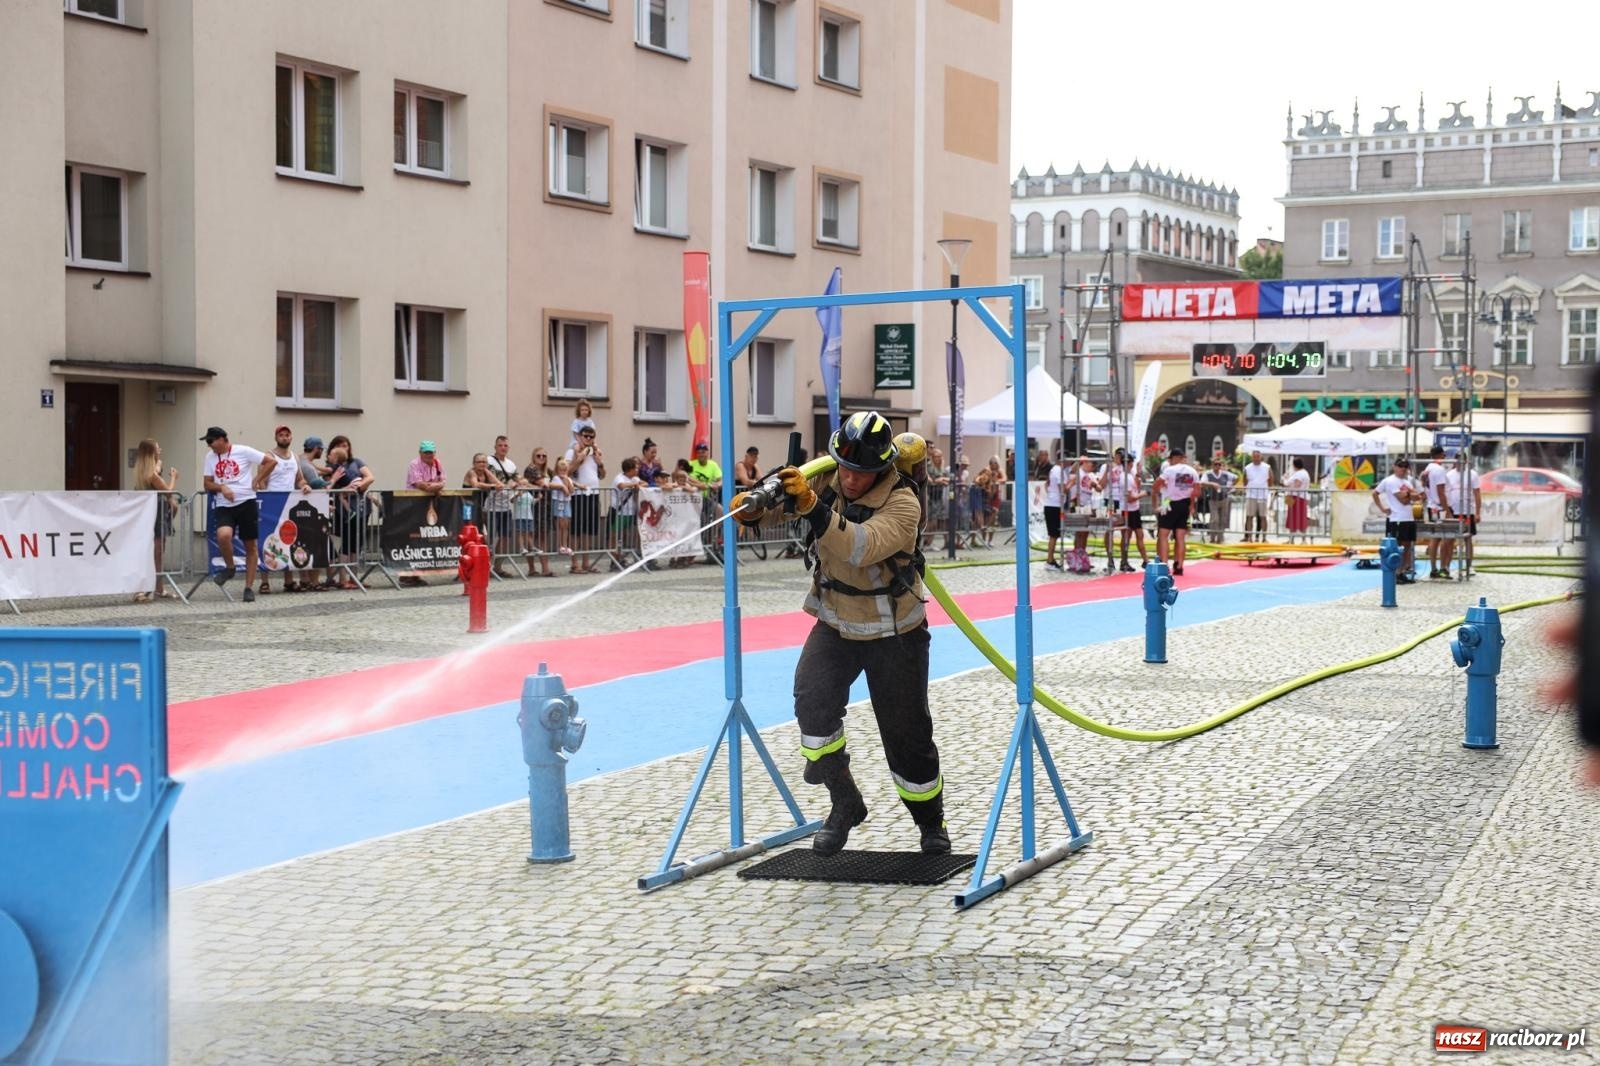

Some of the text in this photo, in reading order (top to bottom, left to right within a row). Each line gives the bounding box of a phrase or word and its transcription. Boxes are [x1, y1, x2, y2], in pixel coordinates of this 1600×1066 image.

[1141, 286, 1237, 318] META
[1282, 283, 1383, 316] META
[1202, 353, 1256, 369] 1:04.70
[1266, 352, 1321, 369] 1:04.70
[391, 545, 434, 561] GAŚNICE
